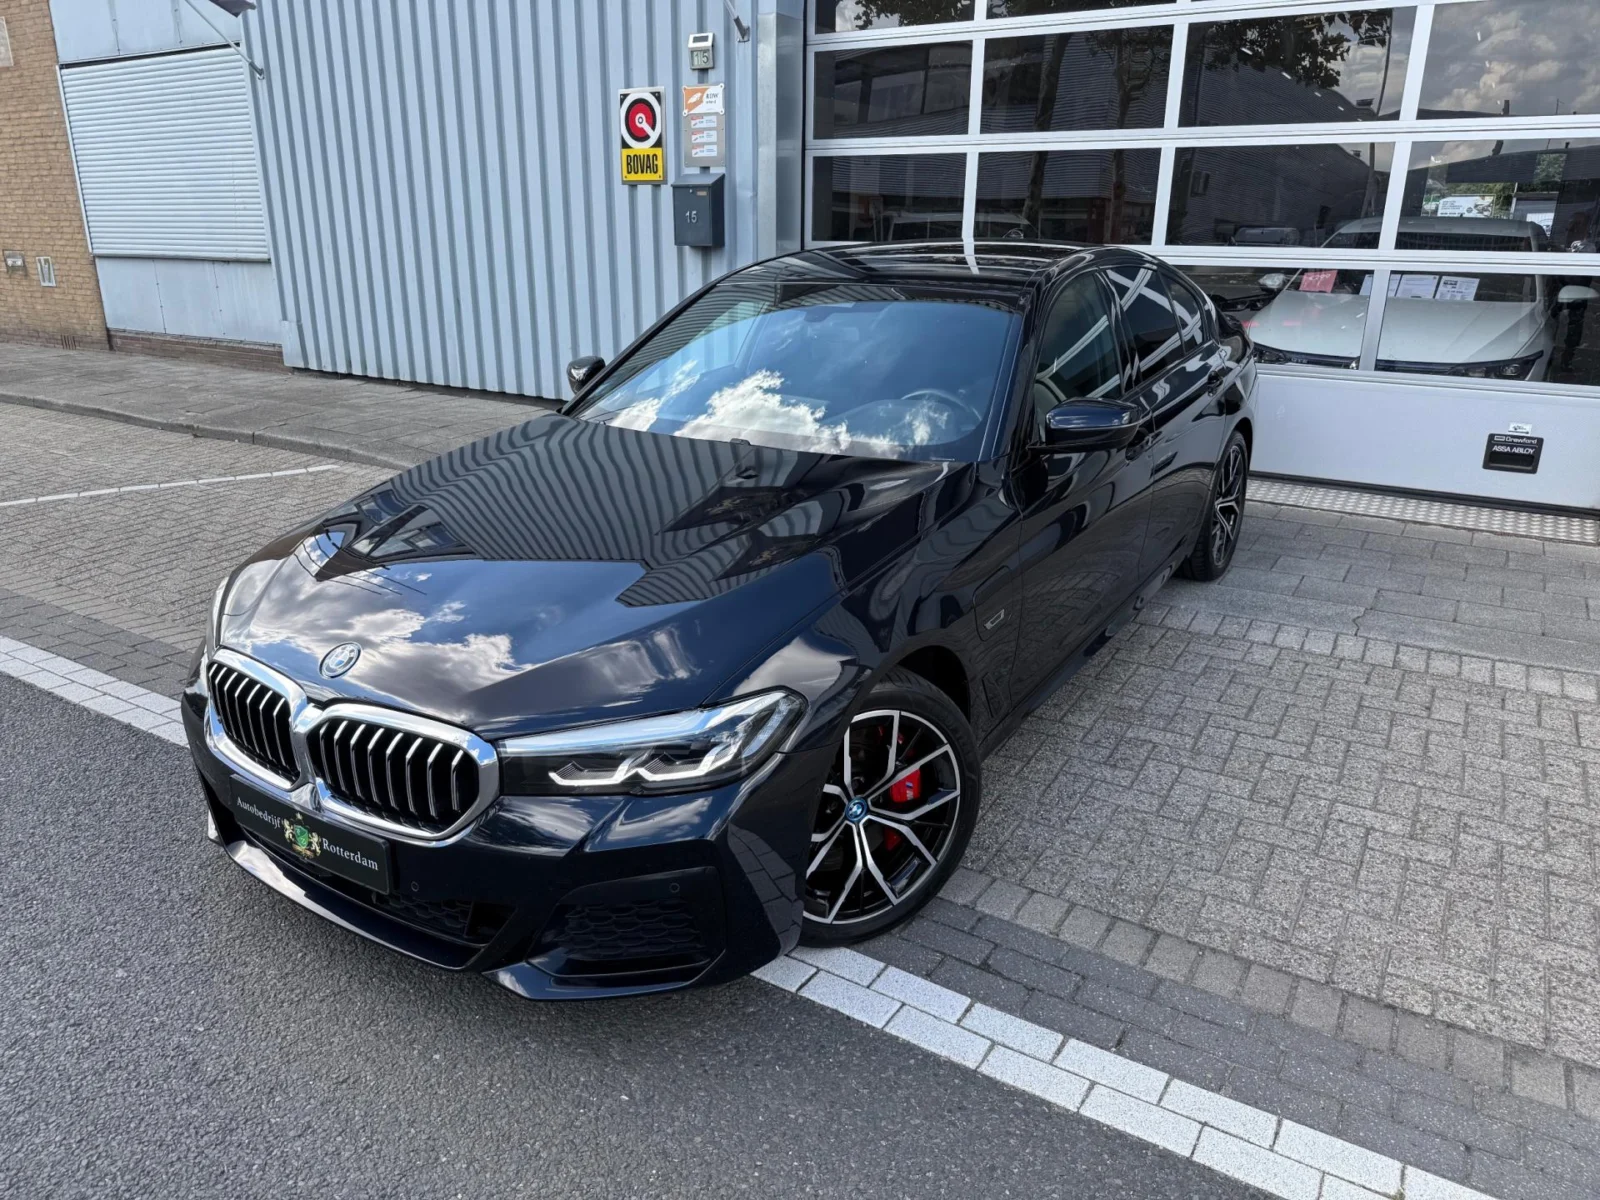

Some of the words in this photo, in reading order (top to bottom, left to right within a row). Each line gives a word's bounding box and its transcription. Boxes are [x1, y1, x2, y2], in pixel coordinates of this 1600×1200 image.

[694, 50, 709, 64] 15
[626, 153, 659, 175] BOVAG
[685, 210, 698, 224] 15
[1492, 445, 1511, 453] ASSA
[1511, 447, 1536, 455] ABLOY
[237, 797, 281, 829] Autobedrijf
[322, 838, 379, 871] Rotterdam
